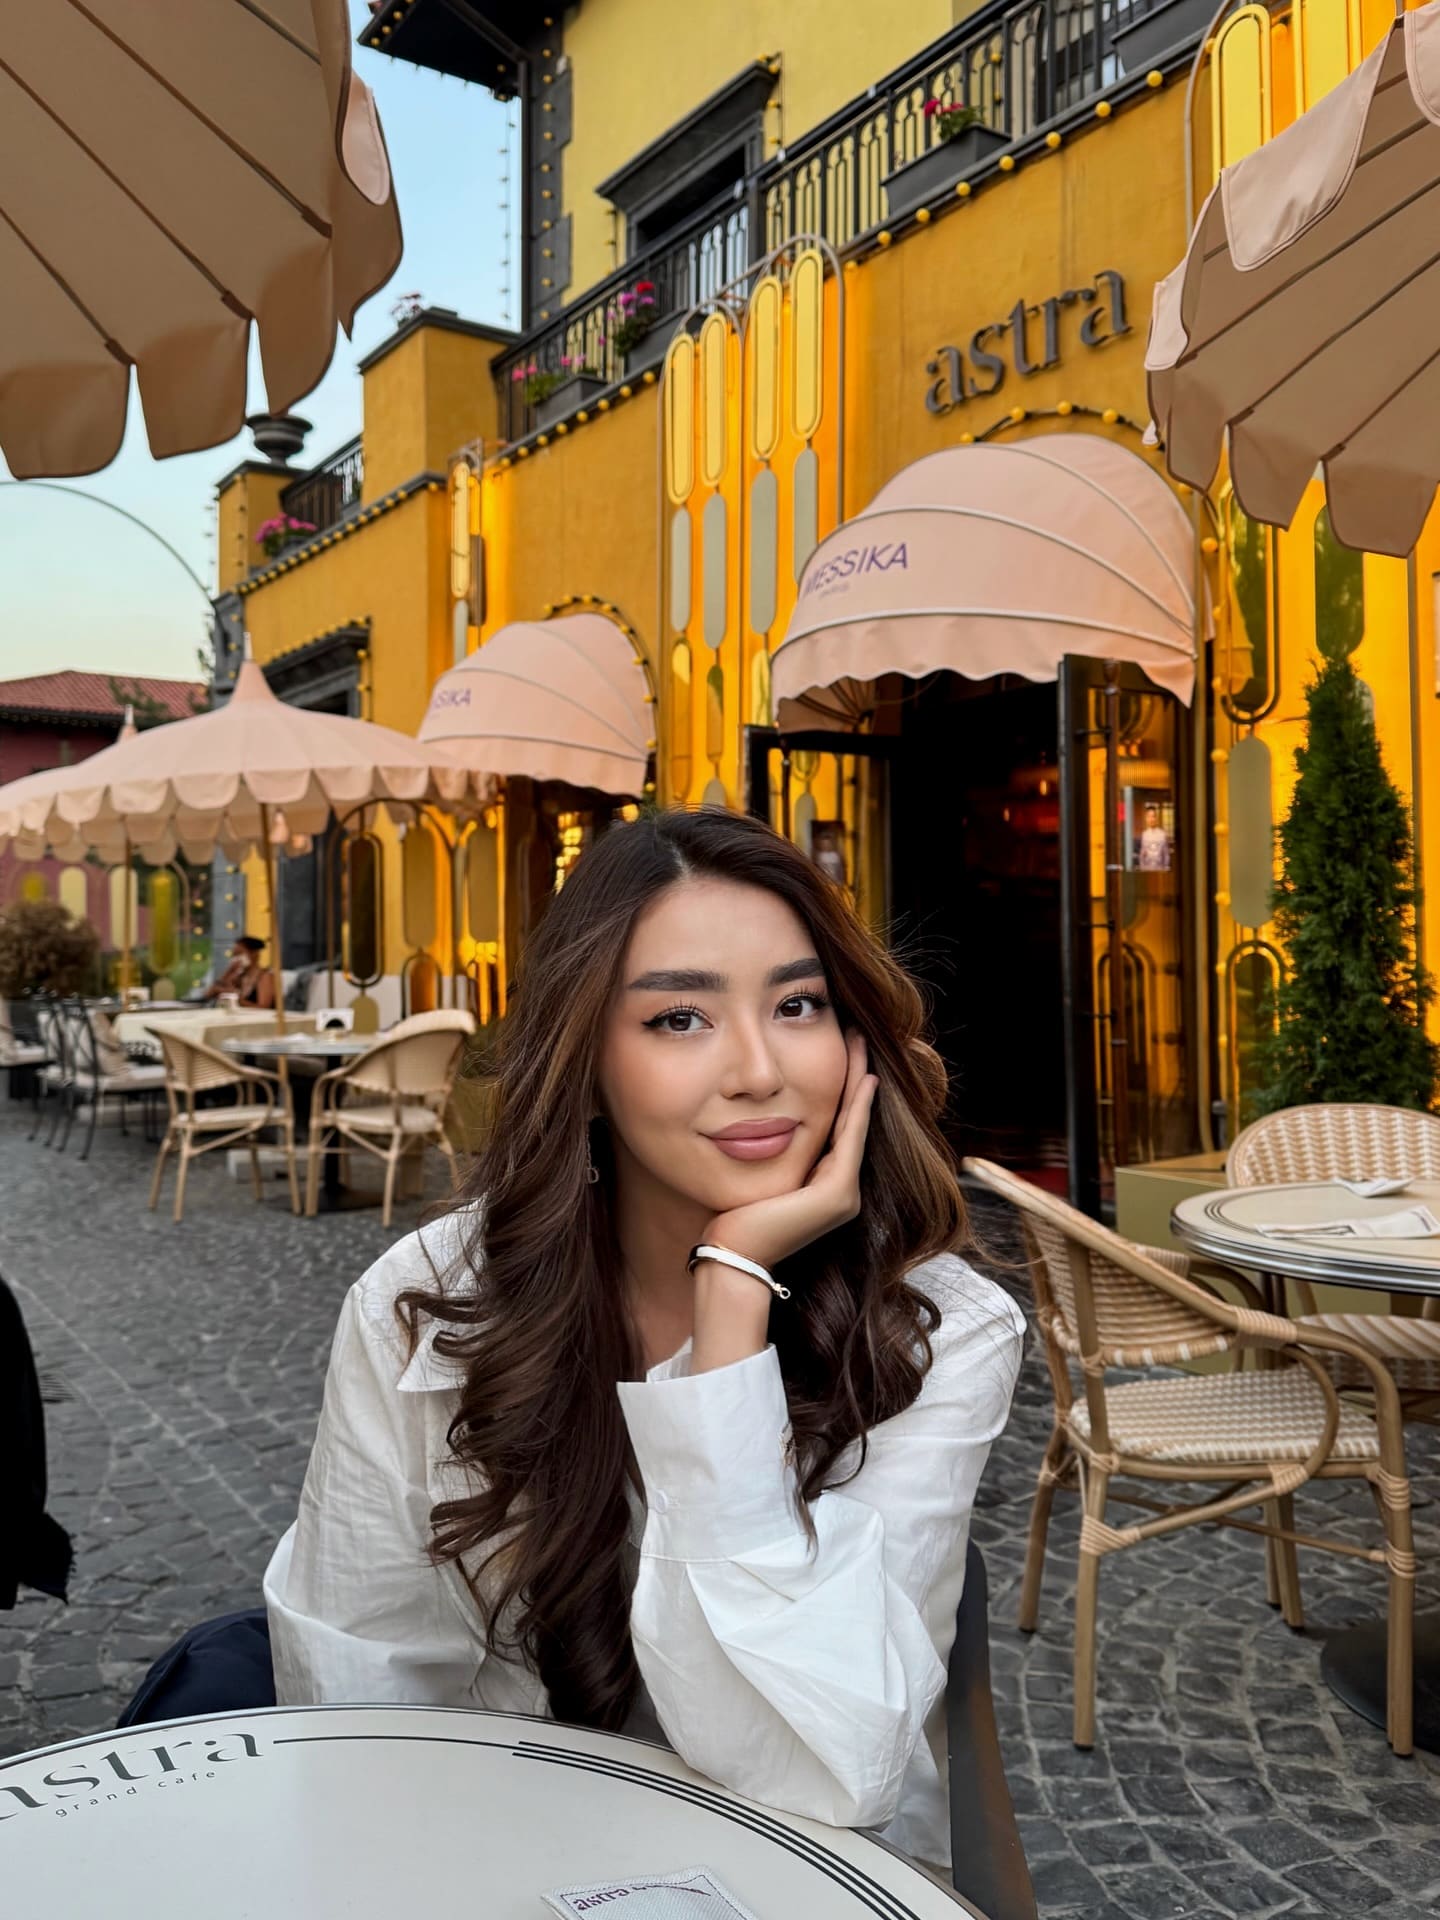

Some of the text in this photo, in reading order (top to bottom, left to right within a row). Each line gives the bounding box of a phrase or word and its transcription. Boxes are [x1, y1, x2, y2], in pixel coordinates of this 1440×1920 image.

[924, 270, 1133, 415] astra
[55, 1769, 216, 1818] grand cafe
[573, 1888, 630, 1911] astra
